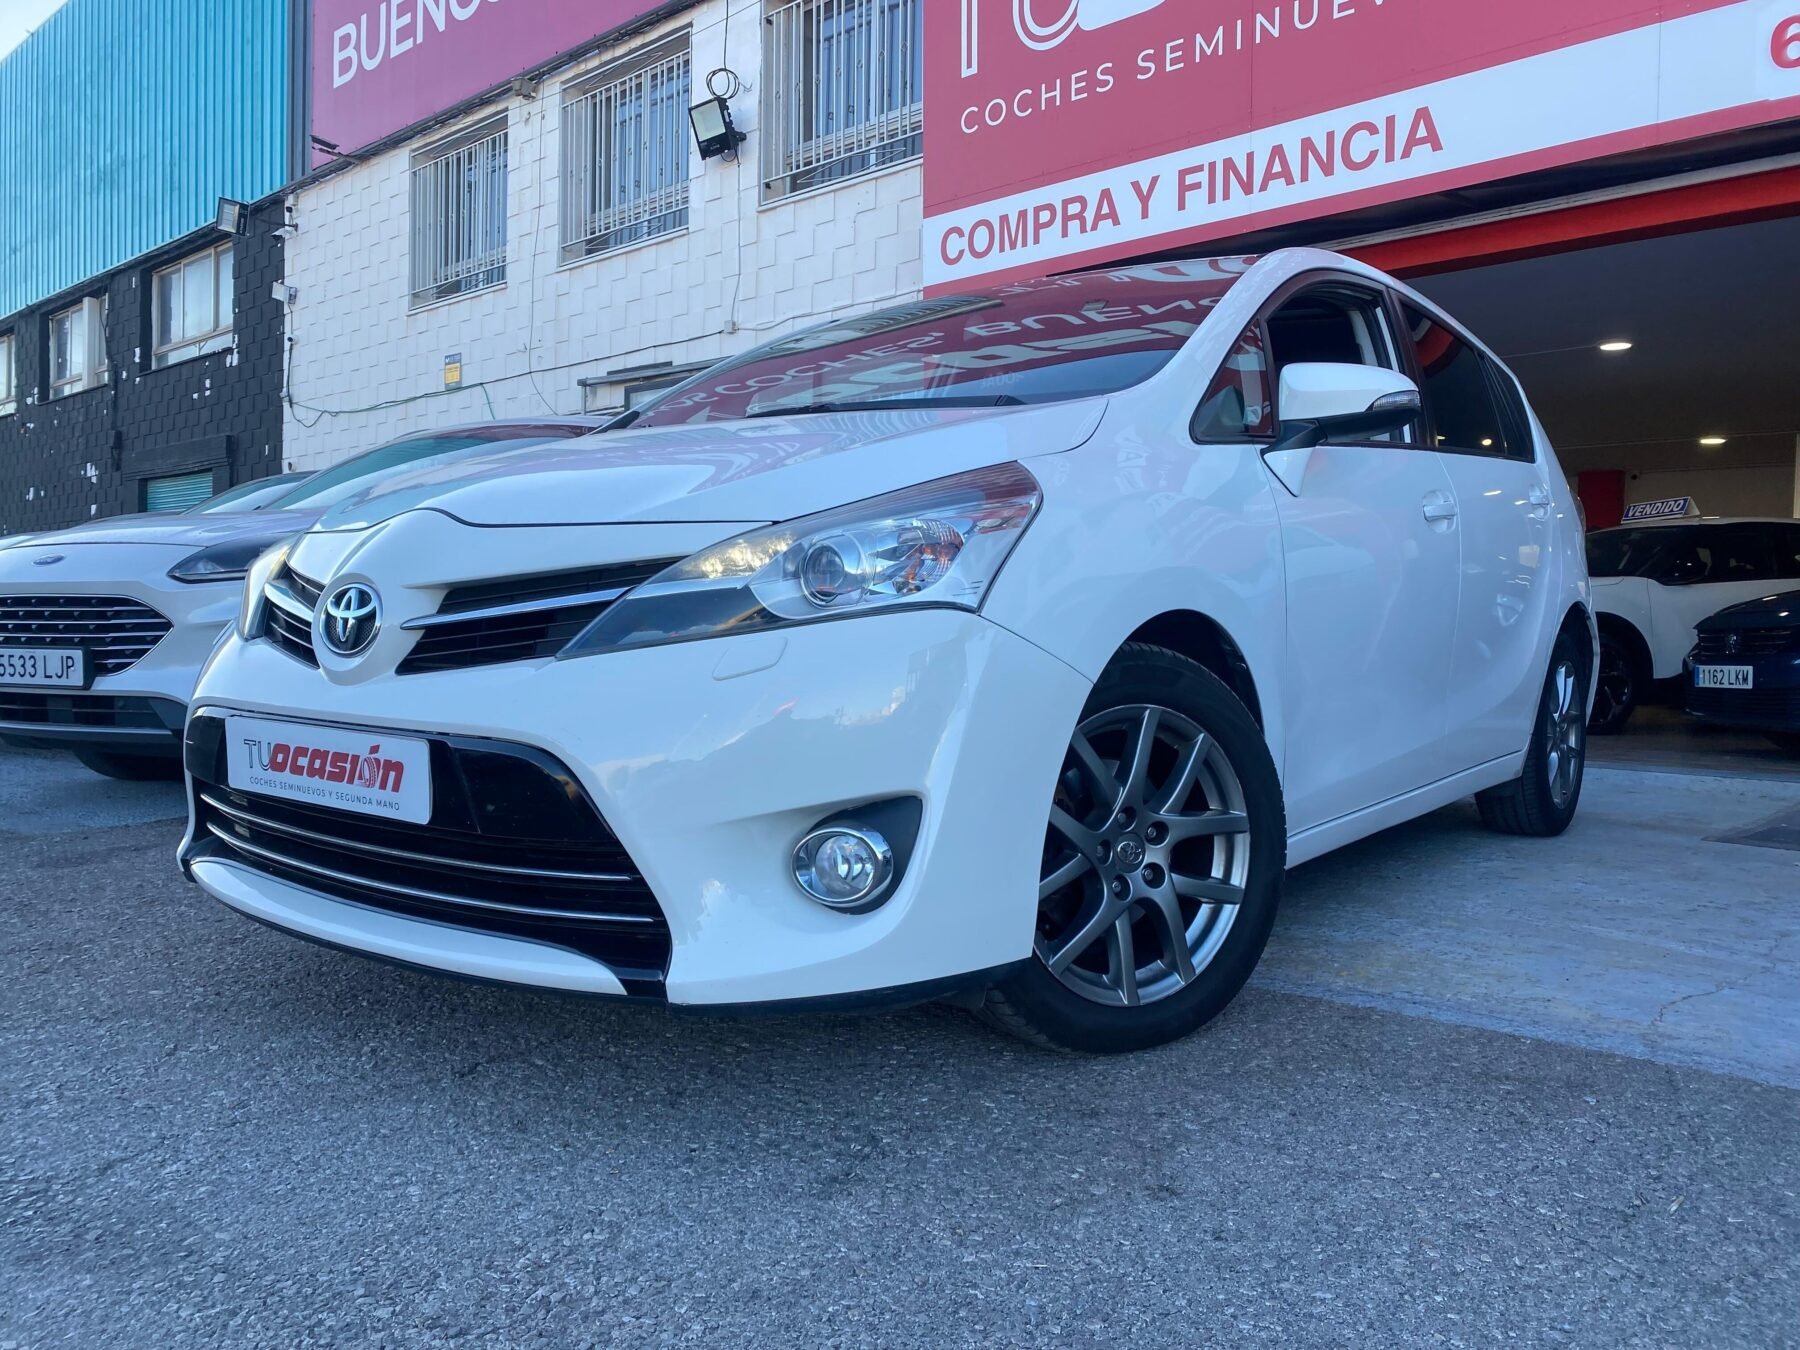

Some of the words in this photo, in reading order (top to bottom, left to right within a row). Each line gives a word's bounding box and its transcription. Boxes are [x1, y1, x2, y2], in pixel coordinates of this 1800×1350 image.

[333, 0, 500, 89] BUEN
[960, 62, 1115, 135] COCHES
[1136, 0, 1384, 81] SEMINUE
[940, 189, 1121, 266] COMPRA
[1130, 174, 1161, 220] Y
[1177, 105, 1445, 212] FINANCIA
[1628, 499, 1685, 517] VENDIDO
[0, 654, 37, 678] 5533
[43, 655, 75, 680] LJP
[1702, 669, 1725, 685] 1162
[1728, 669, 1749, 686] LKM
[249, 776, 277, 788] COCHES
[279, 782, 326, 798] SEMINUEVOS
[328, 791, 334, 799] Y
[335, 792, 373, 806] SEGUNDA
[375, 799, 400, 811] MANO
